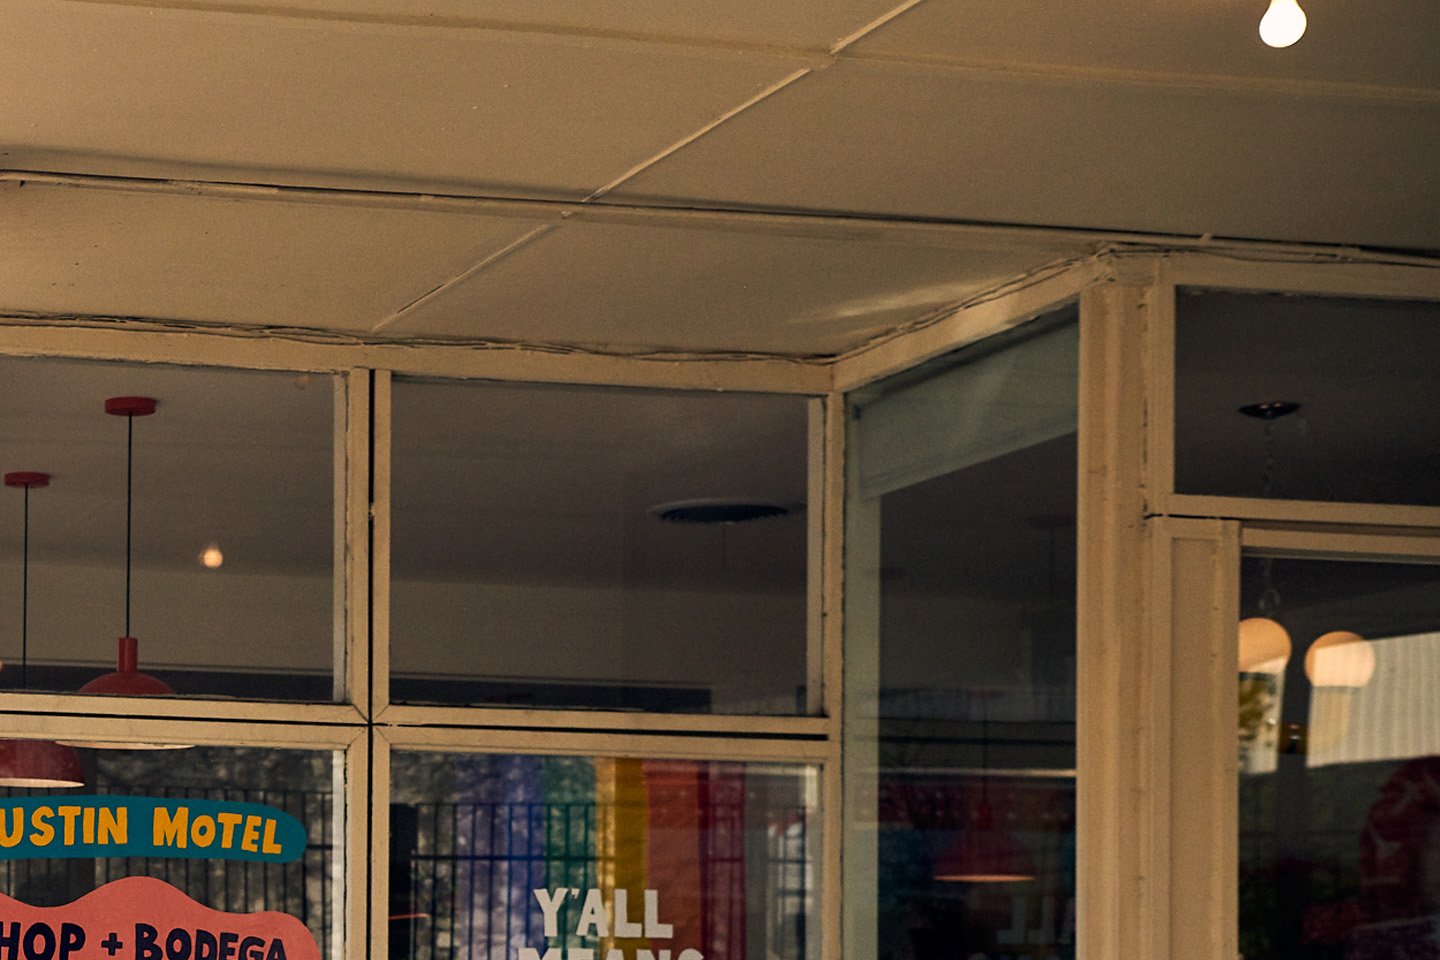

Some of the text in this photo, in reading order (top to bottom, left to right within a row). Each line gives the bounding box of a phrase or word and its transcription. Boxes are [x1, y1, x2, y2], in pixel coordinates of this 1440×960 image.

[153, 806, 282, 854] MOTEL
[533, 888, 674, 939] Y'ALL
[100, 932, 123, 956] +
